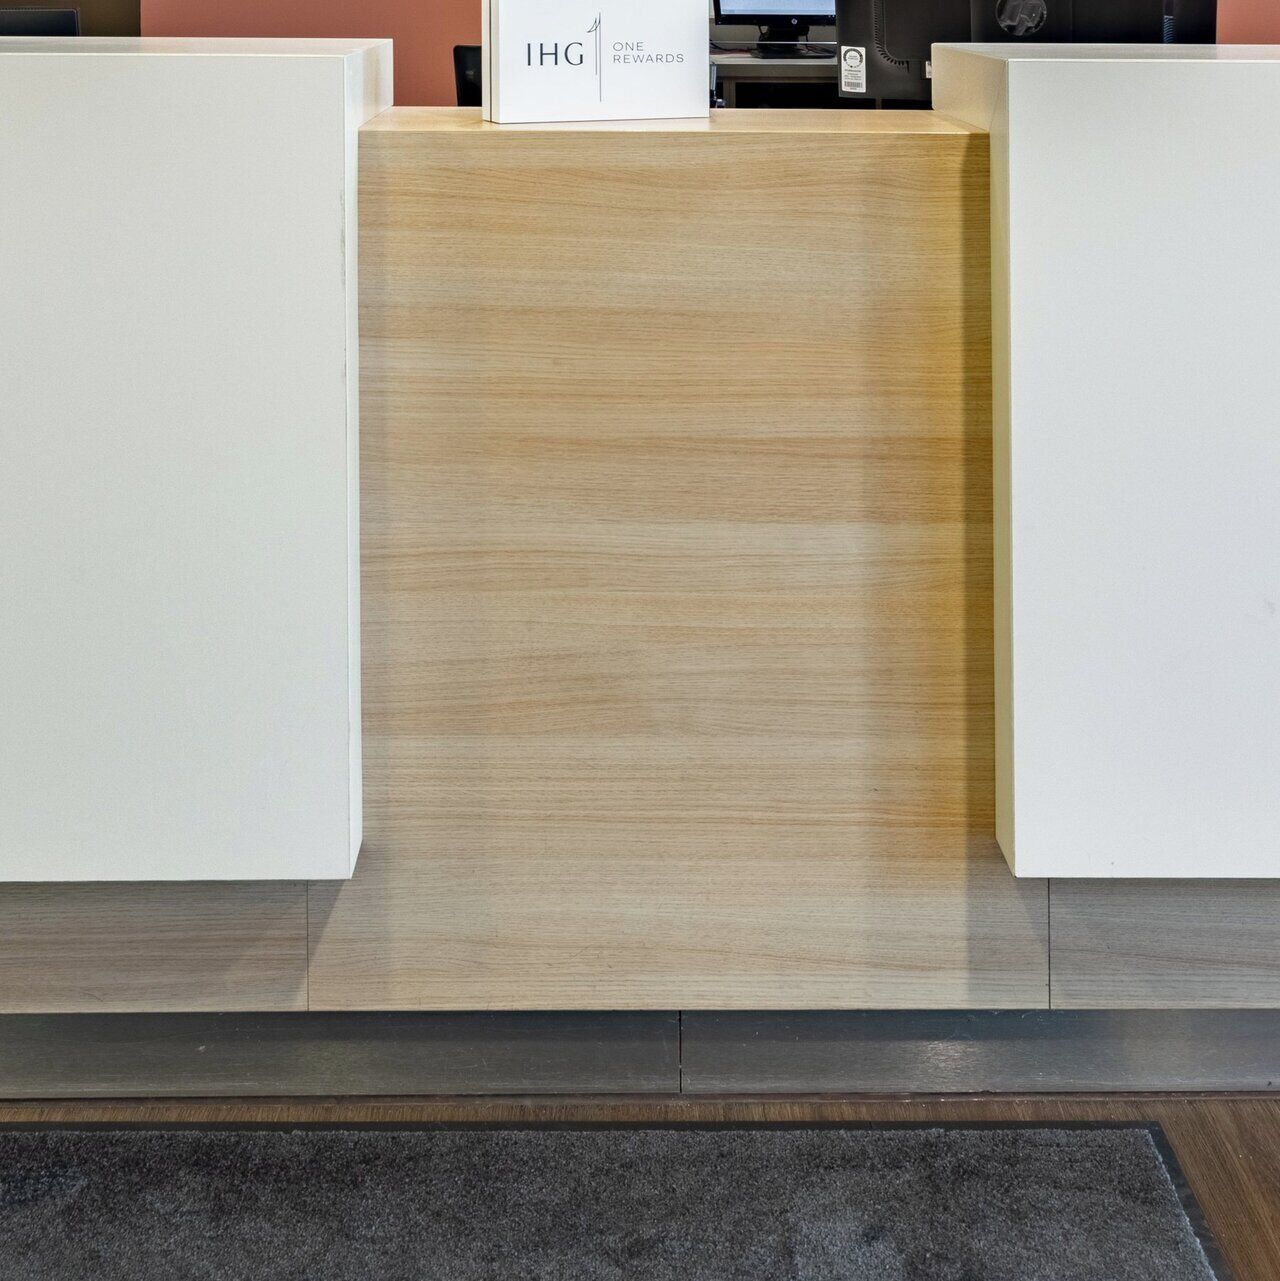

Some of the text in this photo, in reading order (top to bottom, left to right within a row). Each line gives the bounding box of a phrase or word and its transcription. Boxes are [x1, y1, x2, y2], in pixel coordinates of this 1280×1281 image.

[527, 41, 644, 67] IHG ONE
[612, 53, 685, 64] REWARDS
